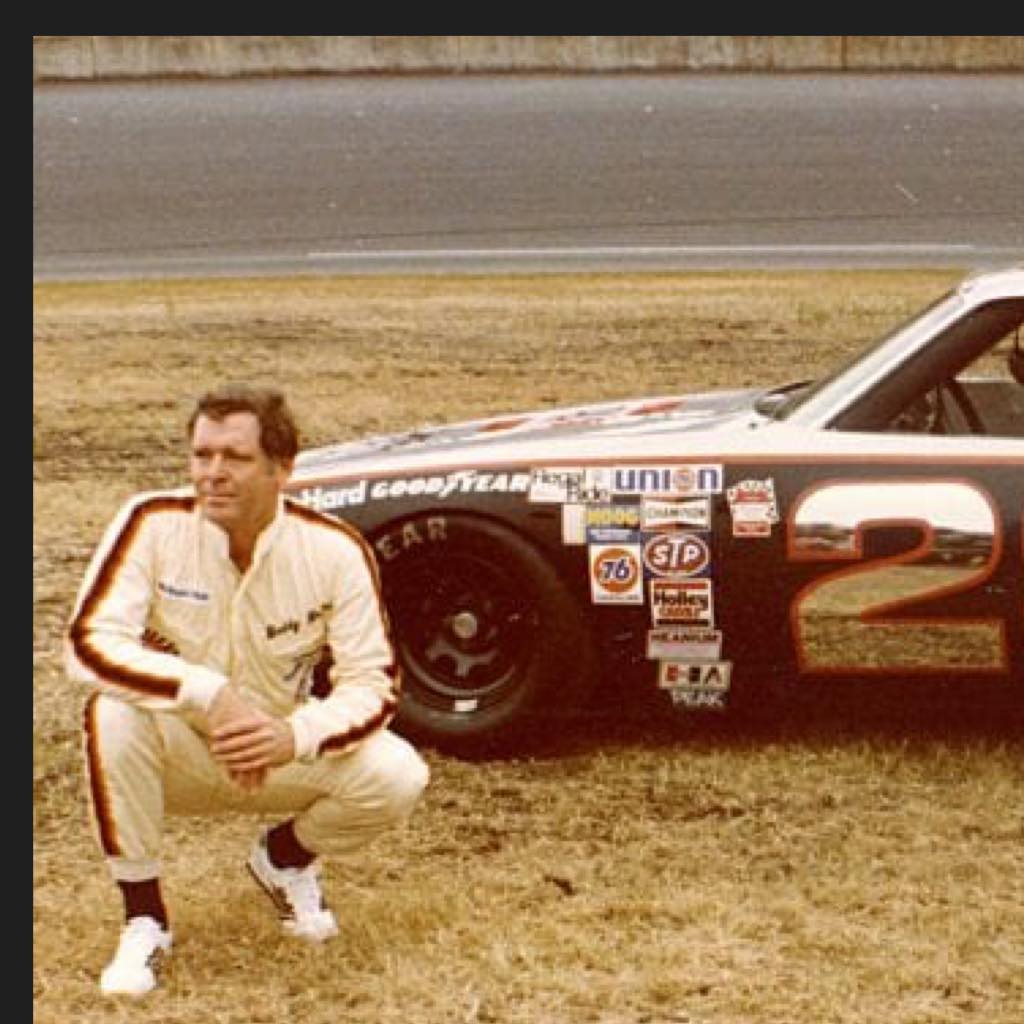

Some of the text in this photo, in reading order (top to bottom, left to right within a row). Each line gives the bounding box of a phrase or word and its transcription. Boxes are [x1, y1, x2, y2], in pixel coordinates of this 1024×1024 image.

[370, 469, 532, 499] GOODYEAR
[651, 535, 702, 569] STP
[600, 555, 632, 580] 76
